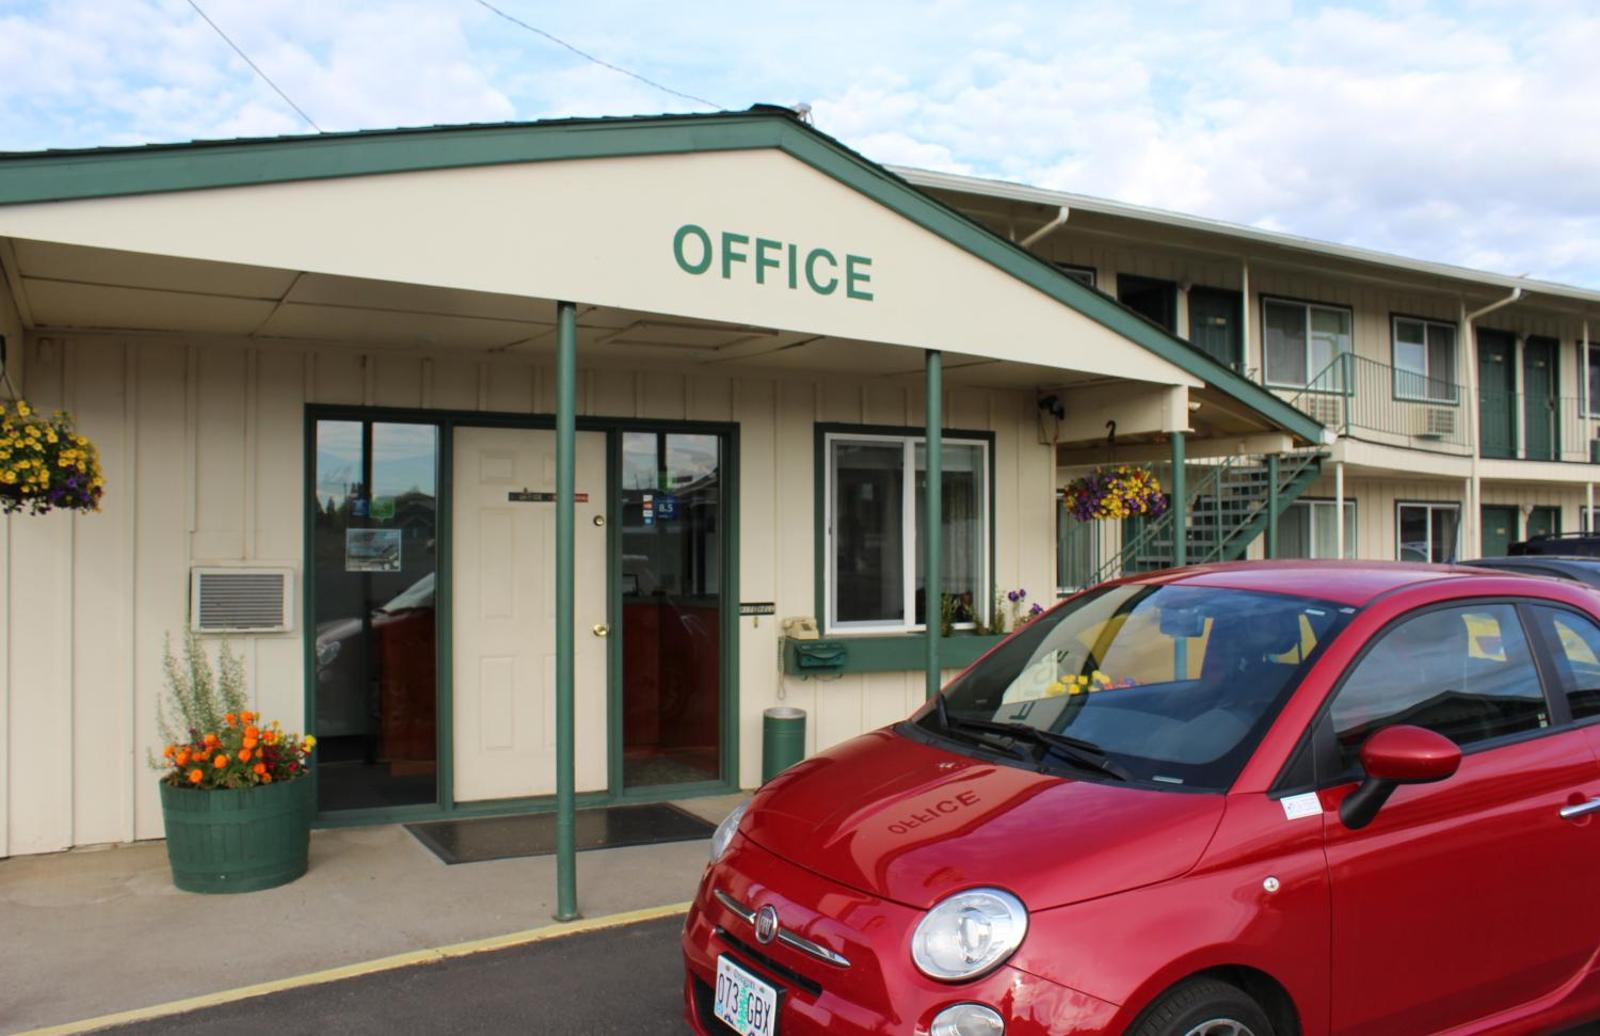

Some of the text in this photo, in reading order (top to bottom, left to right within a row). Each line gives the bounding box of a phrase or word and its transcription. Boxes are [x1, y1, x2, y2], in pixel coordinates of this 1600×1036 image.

[673, 224, 874, 302] OFFICE
[718, 974, 739, 1013] 073
[747, 992, 771, 1036] GBX
